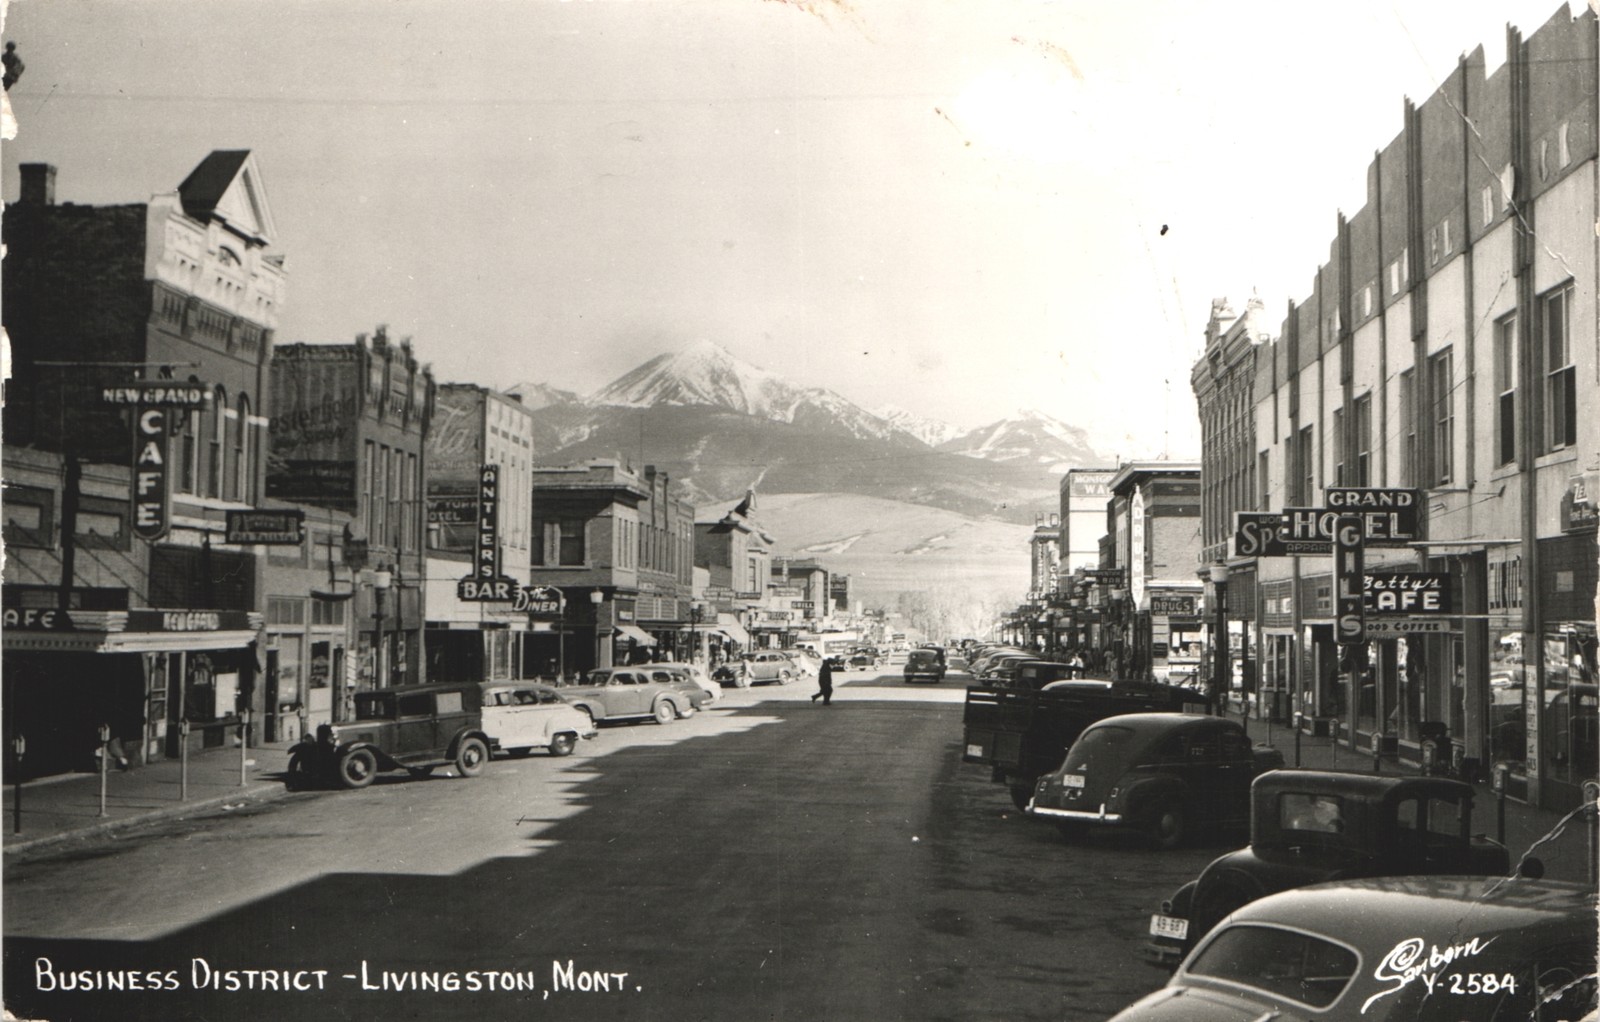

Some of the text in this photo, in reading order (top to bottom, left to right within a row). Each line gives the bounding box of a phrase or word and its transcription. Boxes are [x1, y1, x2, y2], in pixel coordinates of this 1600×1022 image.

[103, 388, 201, 403] NEW GRAND
[137, 410, 163, 527] CAFE
[1328, 491, 1413, 507] GRAND
[428, 511, 461, 521] OTEL
[481, 470, 496, 576] ANTLERS
[1294, 512, 1413, 539] HOEL
[463, 581, 509, 599] BAR
[513, 590, 558, 612] DINER
[1153, 601, 1191, 611] DRUGS
[3, 609, 56, 628] AFE
[1367, 622, 1388, 632] OOD
